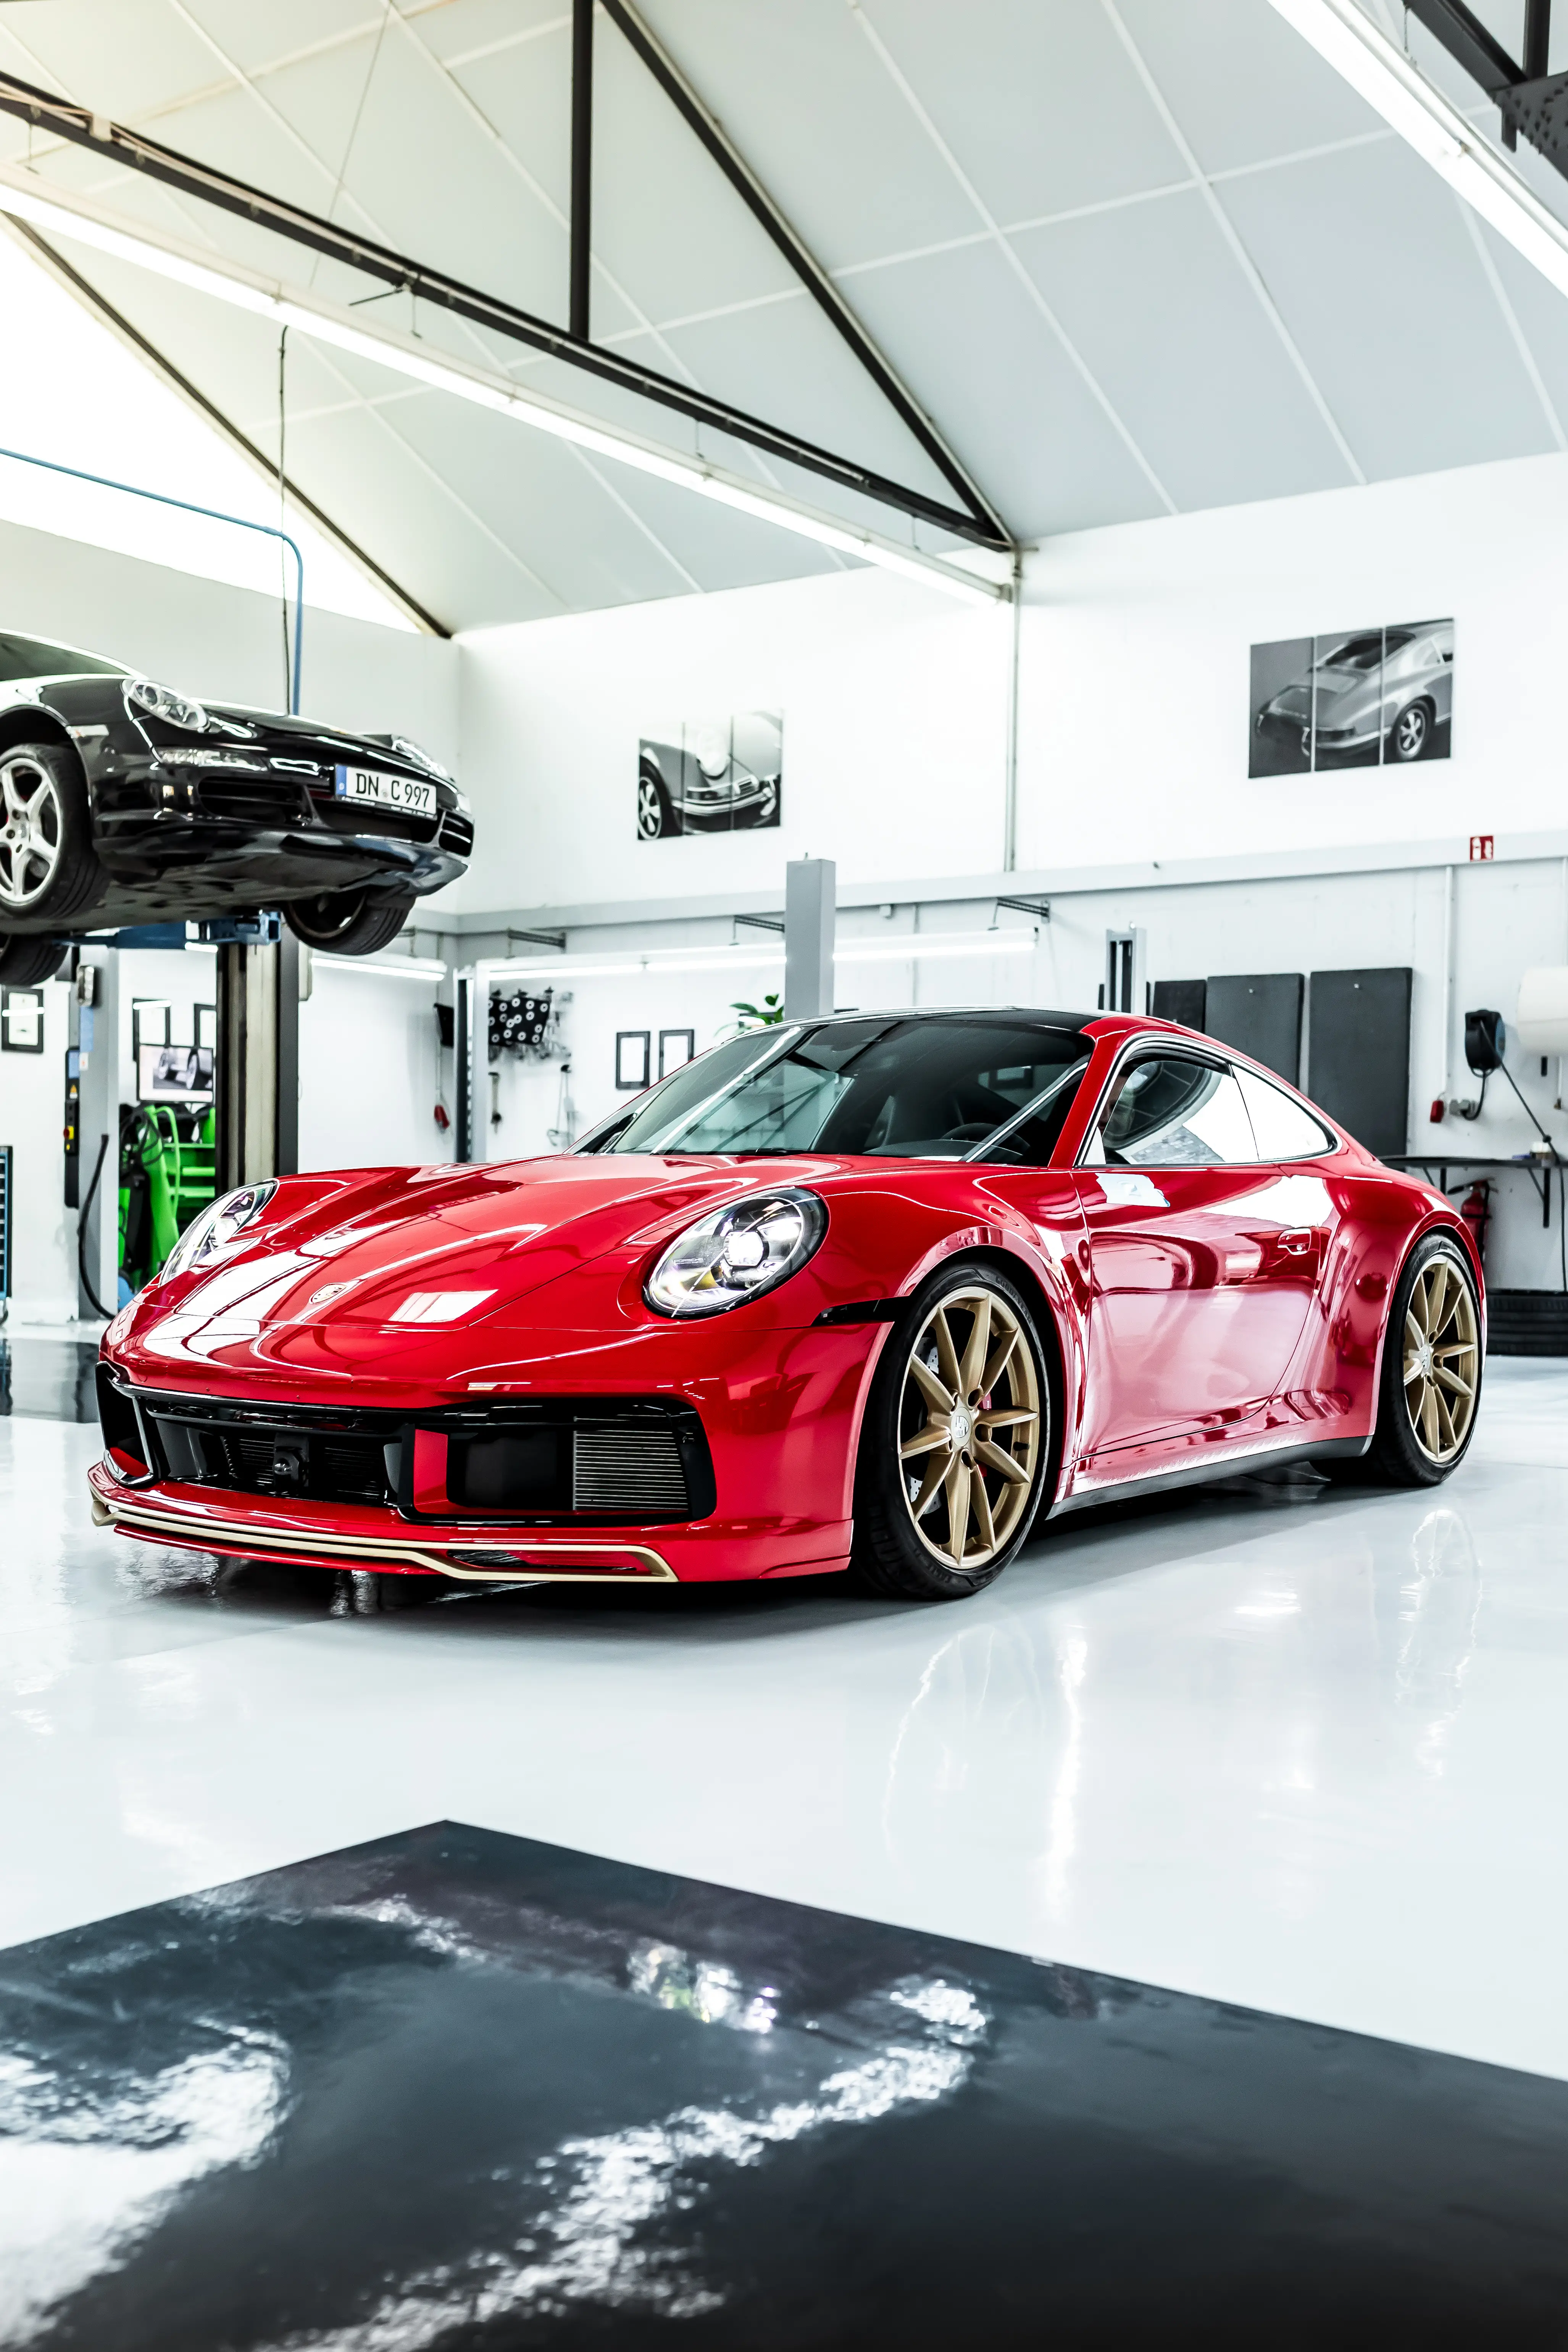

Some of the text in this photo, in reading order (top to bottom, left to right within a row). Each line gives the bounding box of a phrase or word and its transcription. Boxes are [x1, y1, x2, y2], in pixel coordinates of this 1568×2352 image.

[356, 773, 430, 808] DN C 997
